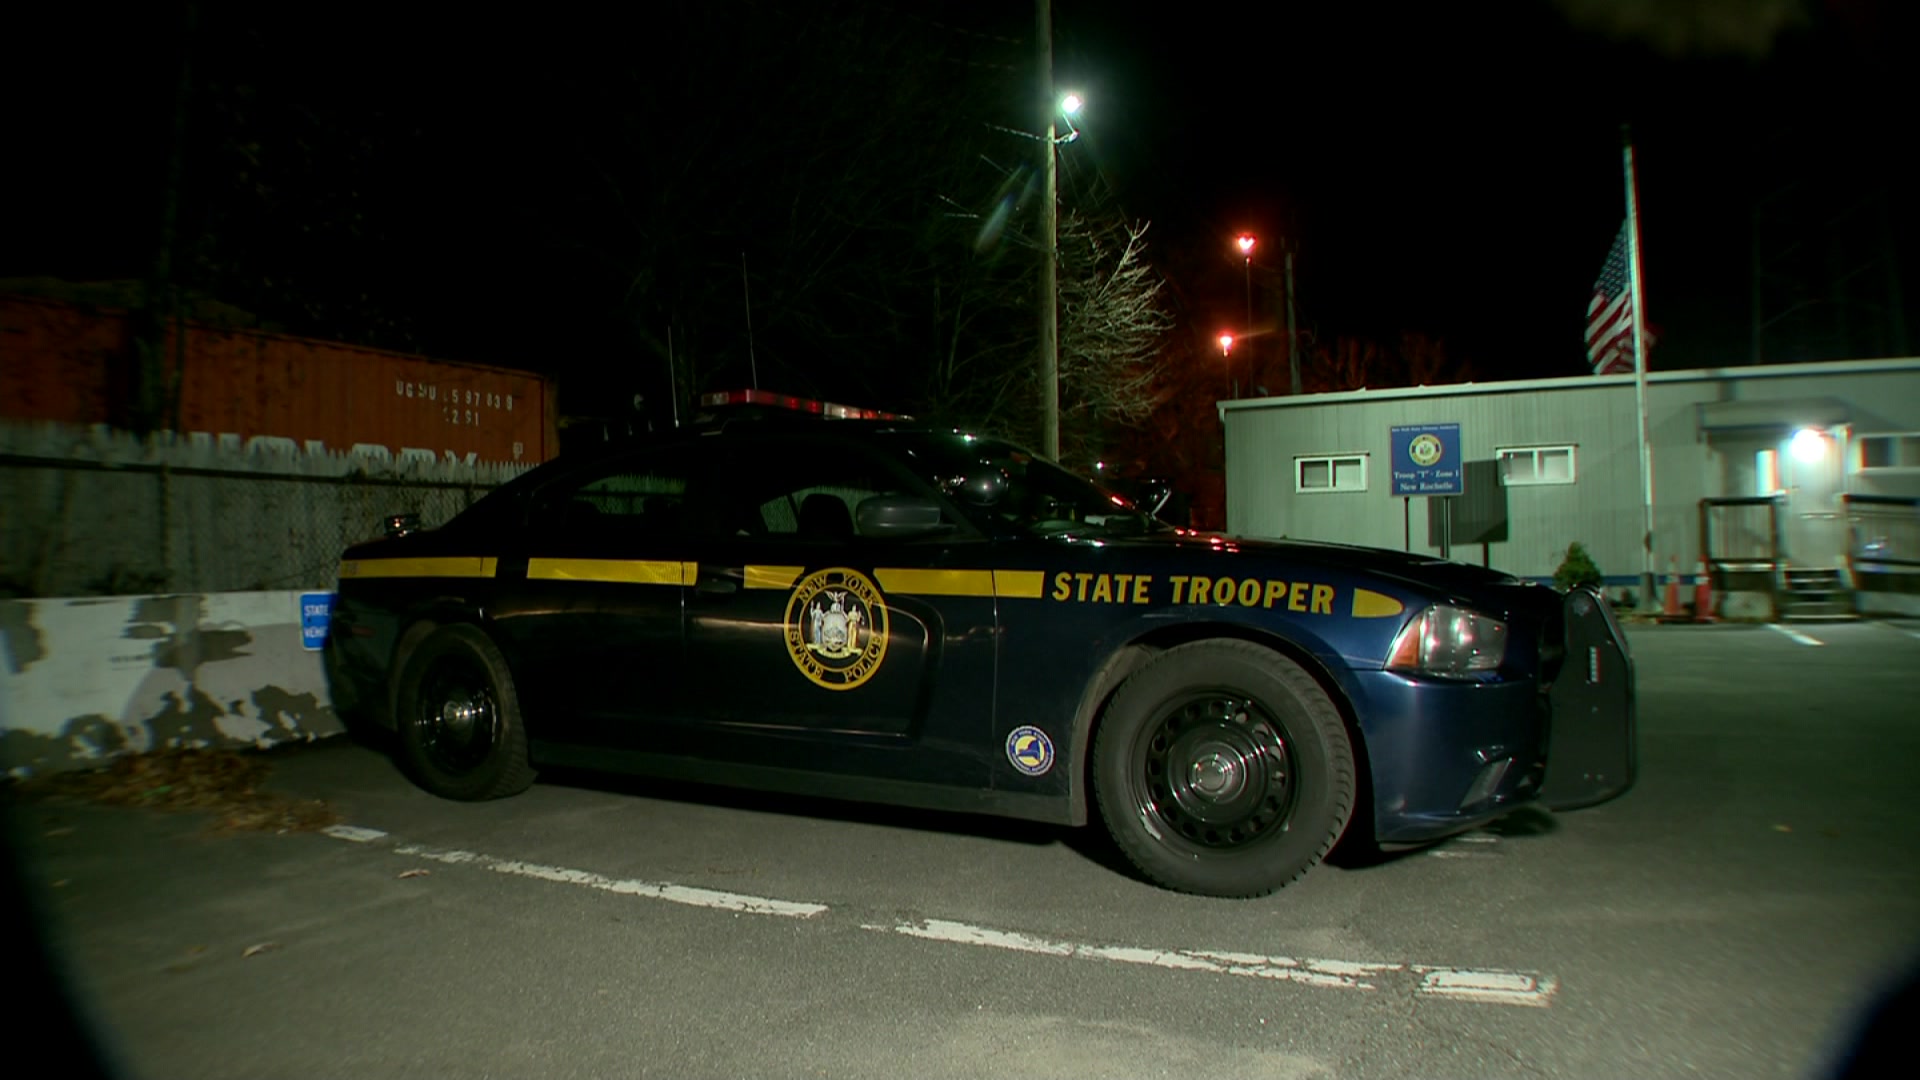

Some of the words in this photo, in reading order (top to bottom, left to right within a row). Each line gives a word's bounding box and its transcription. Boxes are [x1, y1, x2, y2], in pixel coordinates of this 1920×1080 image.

[303, 604, 328, 617] STATE
[797, 573, 828, 604] NEW
[842, 573, 878, 609] YORK
[1051, 571, 1152, 604] STATE
[1169, 575, 1335, 615] TROOPER
[789, 628, 824, 678] STATE
[843, 636, 882, 683] POLICE
